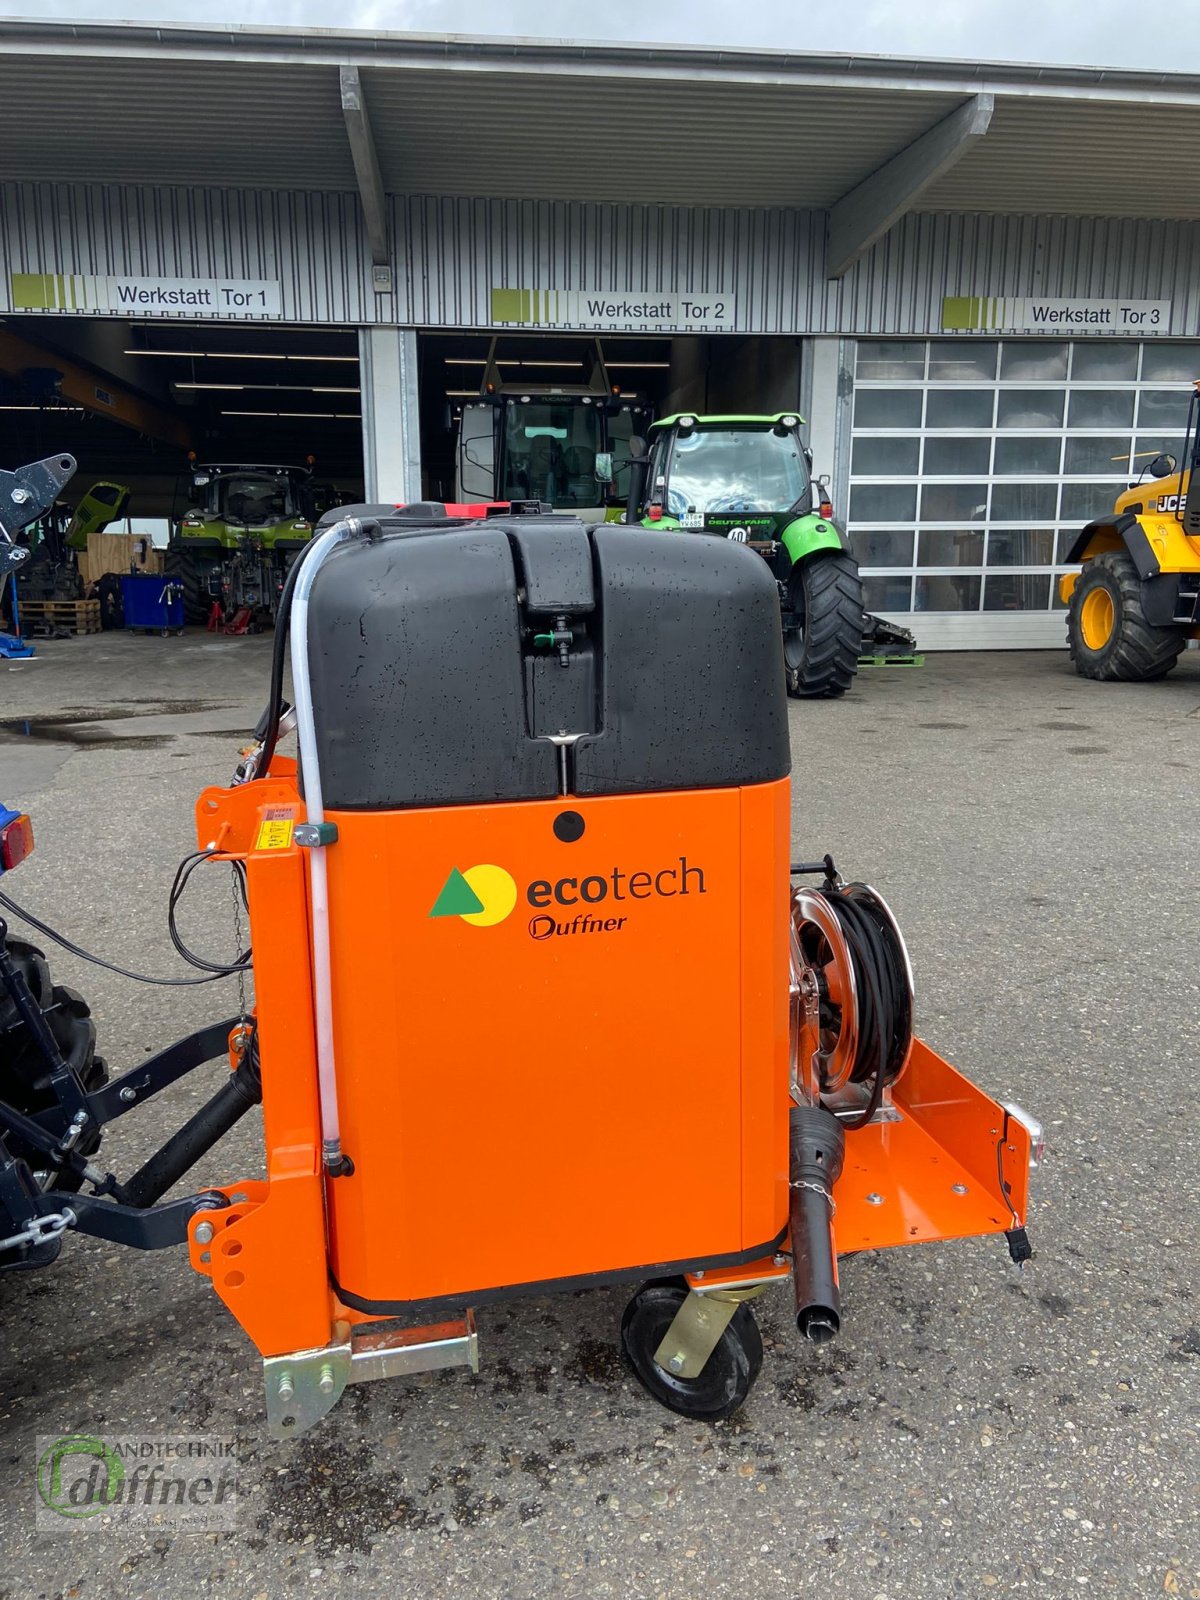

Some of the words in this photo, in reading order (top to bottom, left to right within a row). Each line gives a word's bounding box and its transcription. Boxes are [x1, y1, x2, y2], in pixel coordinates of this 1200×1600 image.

[117, 285, 211, 305] Werkstatt
[221, 288, 252, 306] Tor
[258, 290, 266, 306] 1
[587, 300, 671, 318] Werkstatt
[681, 302, 709, 318] Tor
[714, 303, 724, 319] 2
[1032, 306, 1111, 323] Werkstatt
[1120, 308, 1146, 324] Tor
[1150, 309, 1160, 324] 3
[526, 857, 706, 907] ecotech
[528, 914, 627, 940] Duffner
